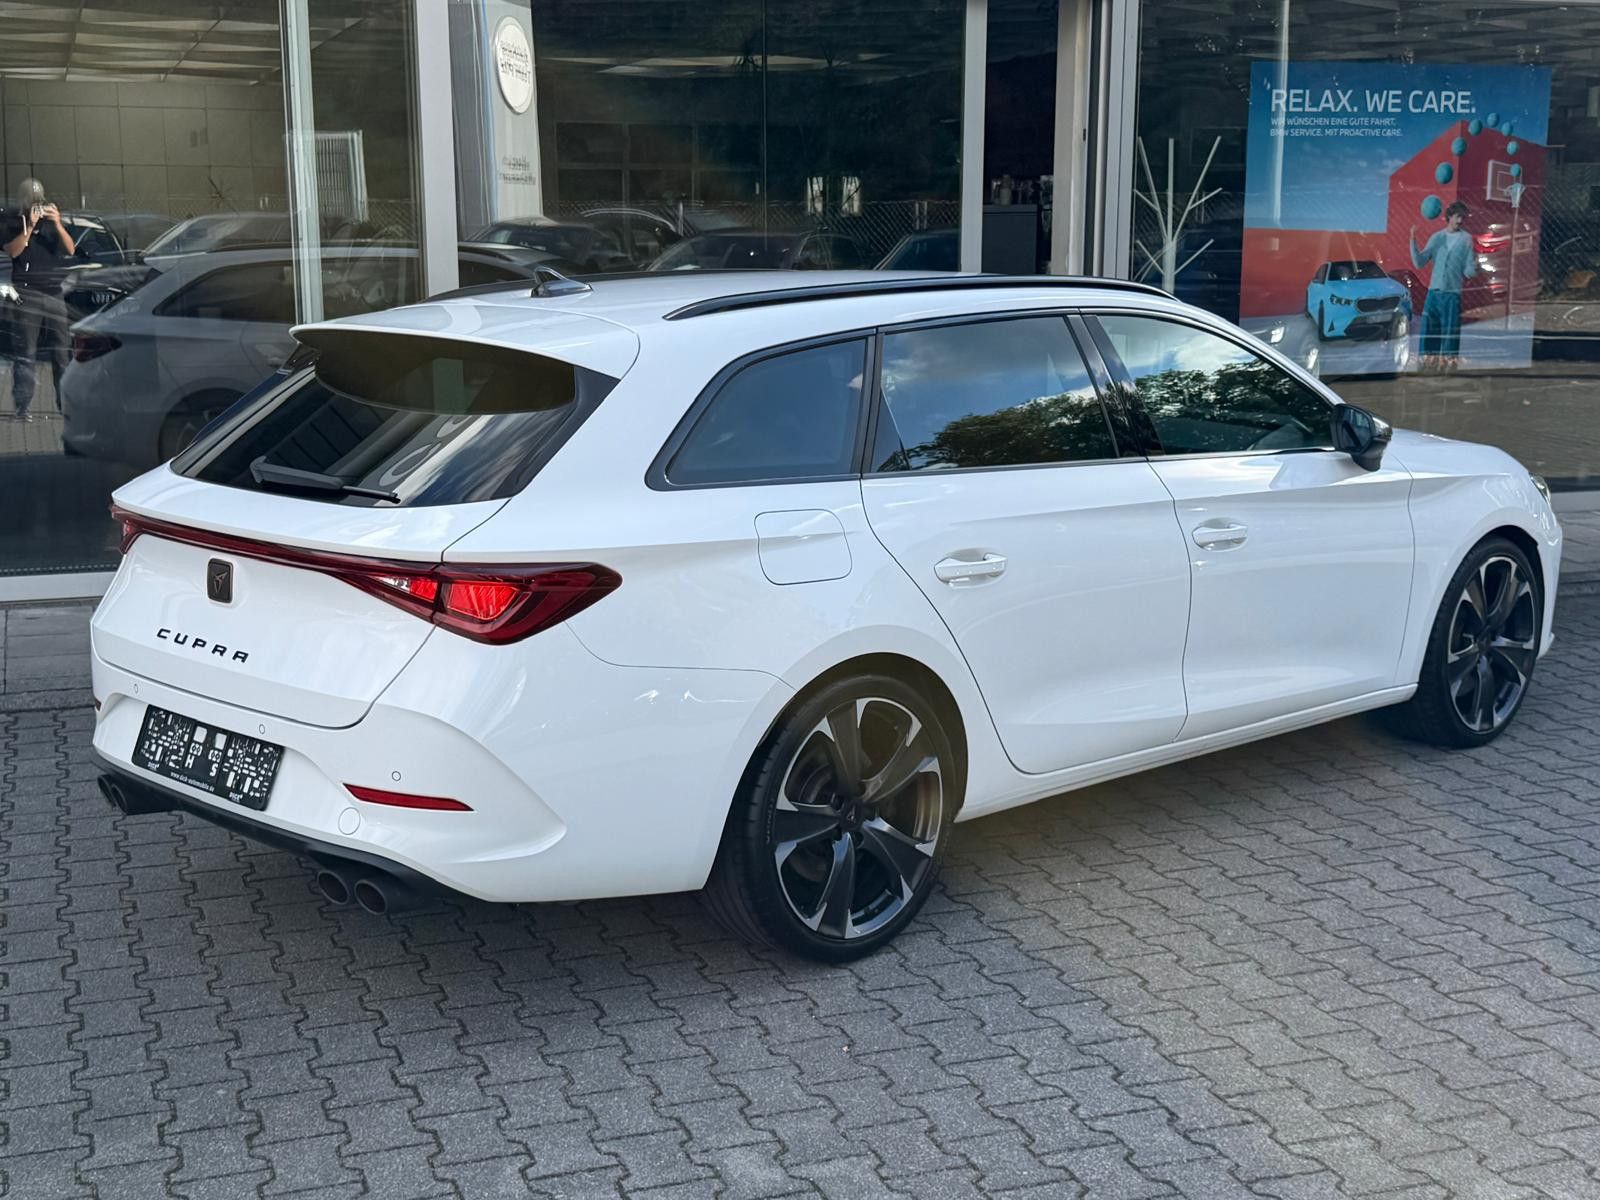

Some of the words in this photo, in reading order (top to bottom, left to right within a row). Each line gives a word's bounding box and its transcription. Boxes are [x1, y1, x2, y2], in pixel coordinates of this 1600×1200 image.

[1271, 89, 1358, 112] RELAX.
[1365, 90, 1402, 112] WE
[1408, 90, 1476, 113] CARE.
[1287, 116, 1330, 126] WÜNSCHEN
[1331, 117, 1348, 126] EINE
[1349, 117, 1369, 126] GUTE
[1325, 129, 1339, 137] MIT
[1340, 129, 1381, 137] PROACTIVE
[156, 628, 249, 663] CUPRA
